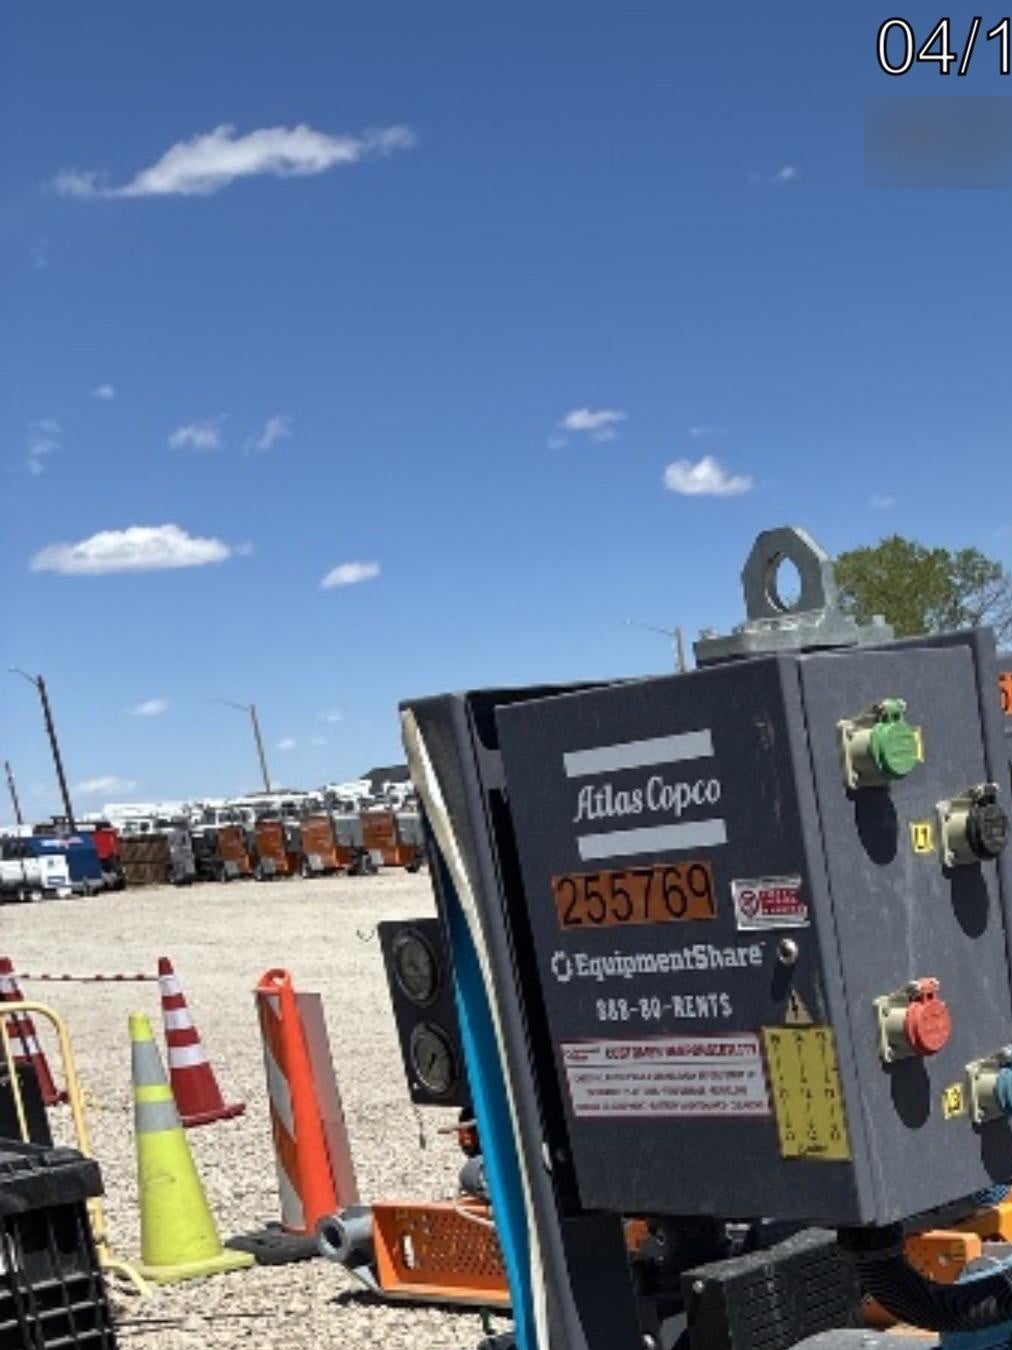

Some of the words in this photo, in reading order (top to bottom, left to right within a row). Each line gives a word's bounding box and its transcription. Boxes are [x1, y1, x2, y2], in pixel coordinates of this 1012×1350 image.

[573, 785, 643, 823] Atlas
[648, 776, 721, 817] Copco
[557, 864, 715, 925] 255769
[575, 944, 762, 982] EquipmentShare
